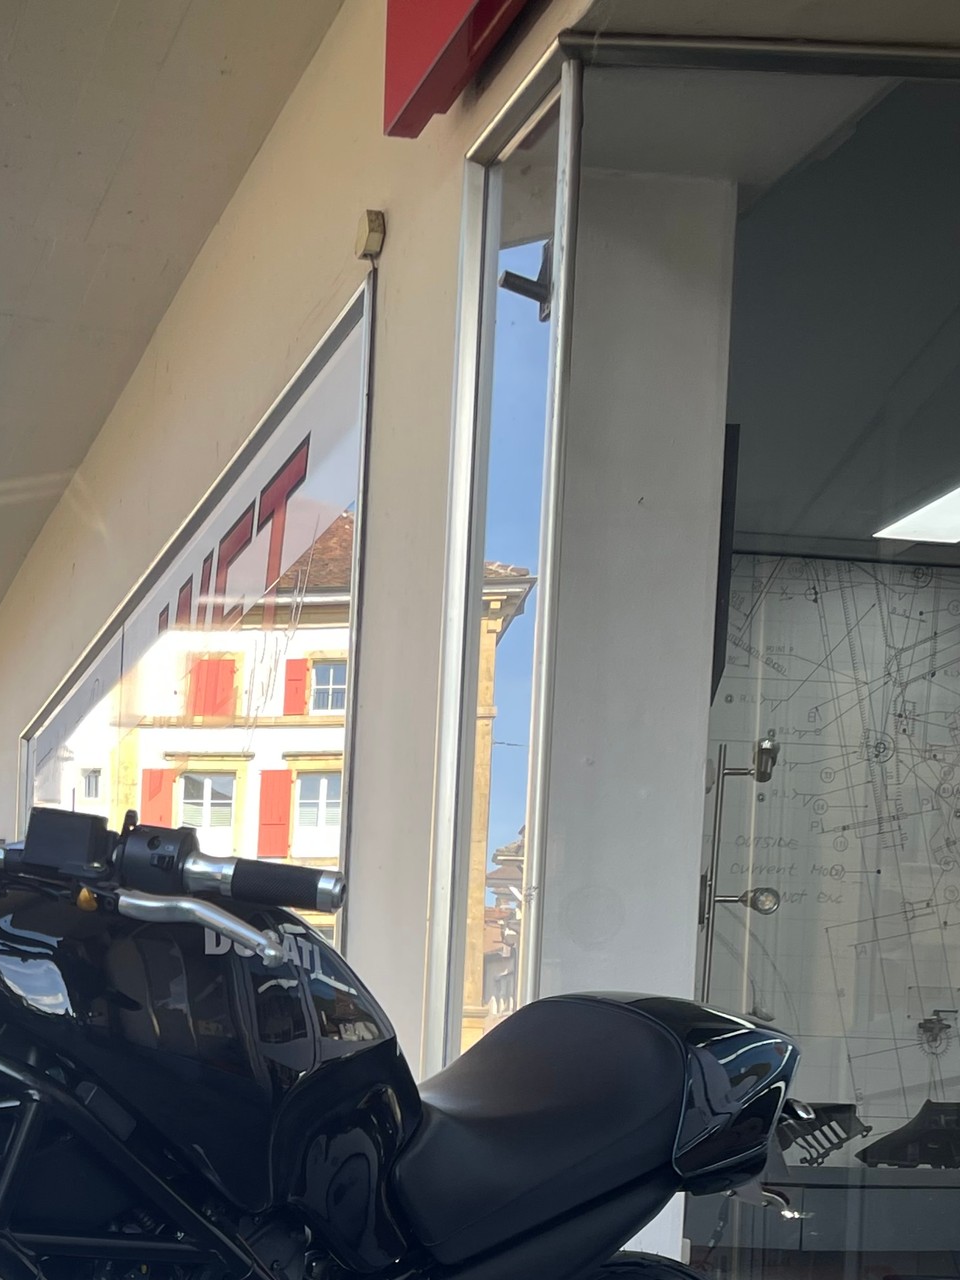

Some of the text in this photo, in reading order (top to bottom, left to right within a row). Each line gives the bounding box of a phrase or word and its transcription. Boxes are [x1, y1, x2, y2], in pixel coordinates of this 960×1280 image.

[735, 834, 801, 850] OUTSIDE
[730, 862, 799, 876] Current
[204, 927, 323, 972] DATI
